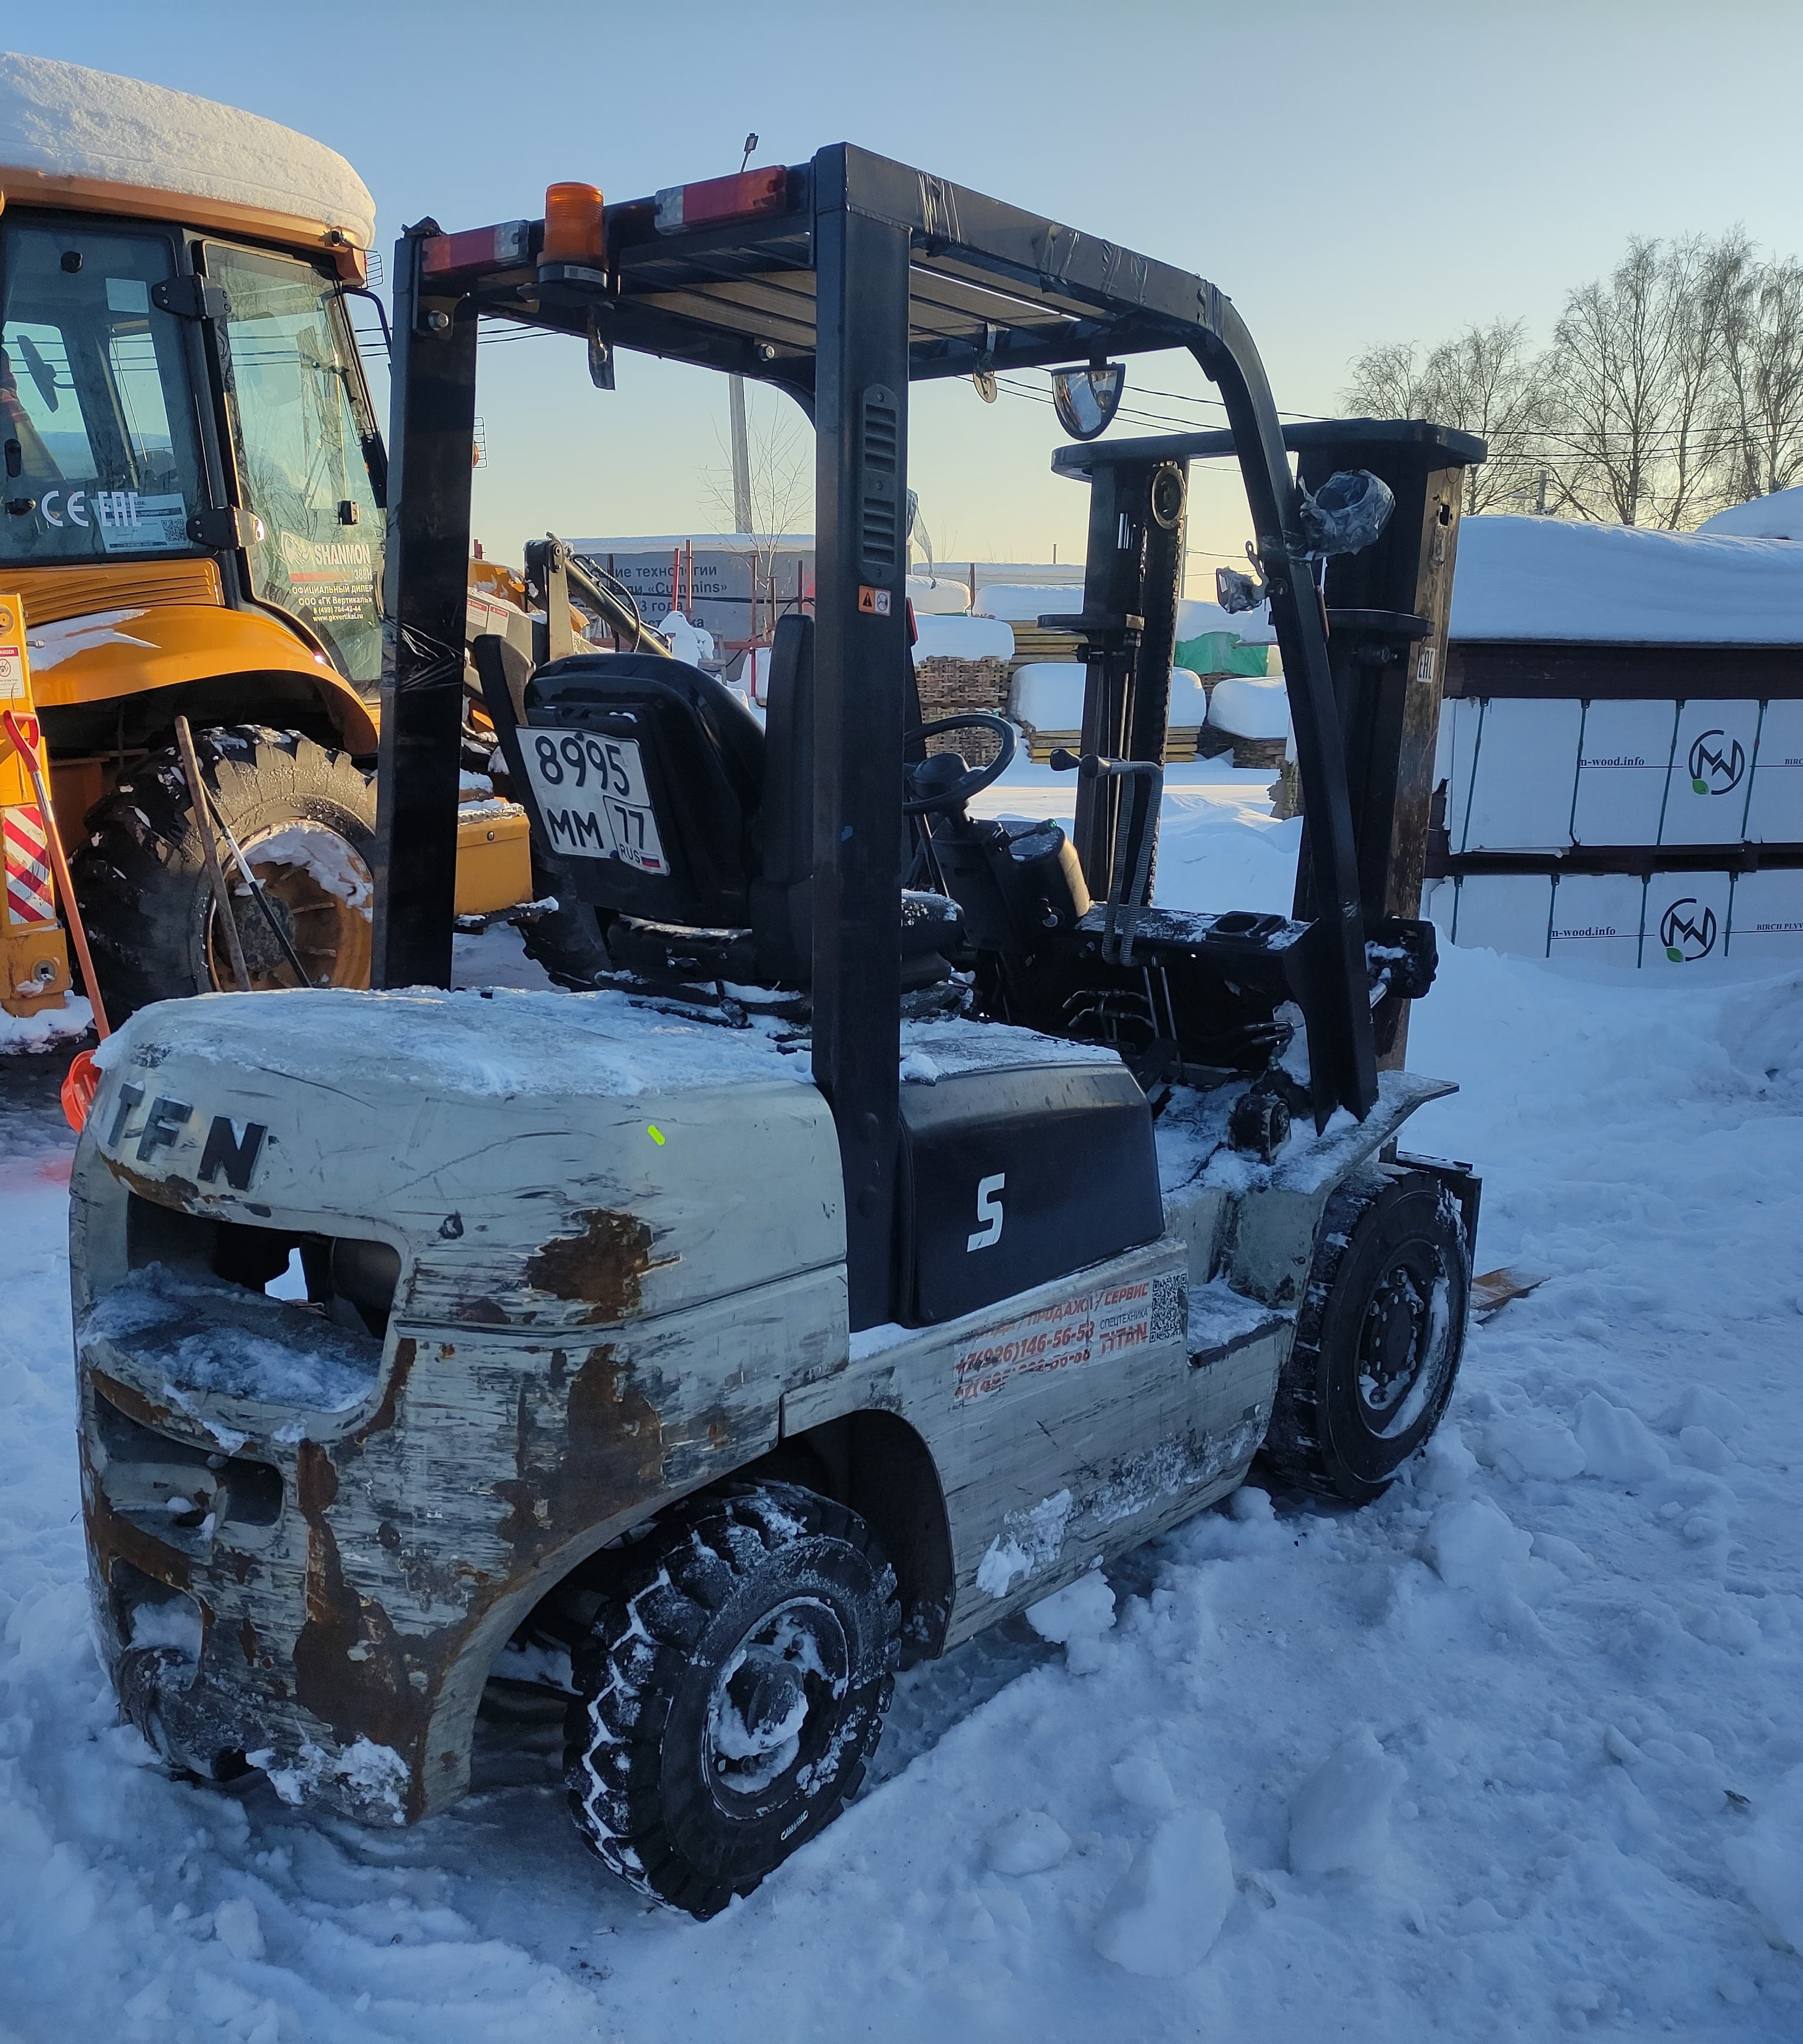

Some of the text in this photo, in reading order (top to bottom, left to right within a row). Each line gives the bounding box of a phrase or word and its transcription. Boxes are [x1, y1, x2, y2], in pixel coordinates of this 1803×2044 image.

[41, 490, 89, 527] CE
[98, 492, 141, 527] EAC
[314, 544, 372, 565] SHANMON
[292, 584, 374, 595] ОФИЦИАЛЬНЫЙ ДИЛЕР
[298, 597, 316, 606] ООО
[332, 595, 373, 606] Вертикаль»
[318, 606, 333, 615] (499)
[334, 605, 361, 613] 704-42-44
[313, 613, 363, 622] www.gkvertikal.ru
[535, 735, 630, 796] 8995
[614, 804, 644, 850] 77
[619, 843, 640, 864] RUS
[1551, 926, 1616, 937] m-wood.info
[967, 1173, 1005, 1252] S
[1100, 1308, 1148, 1330] СПЕЦТЕХНИКА
